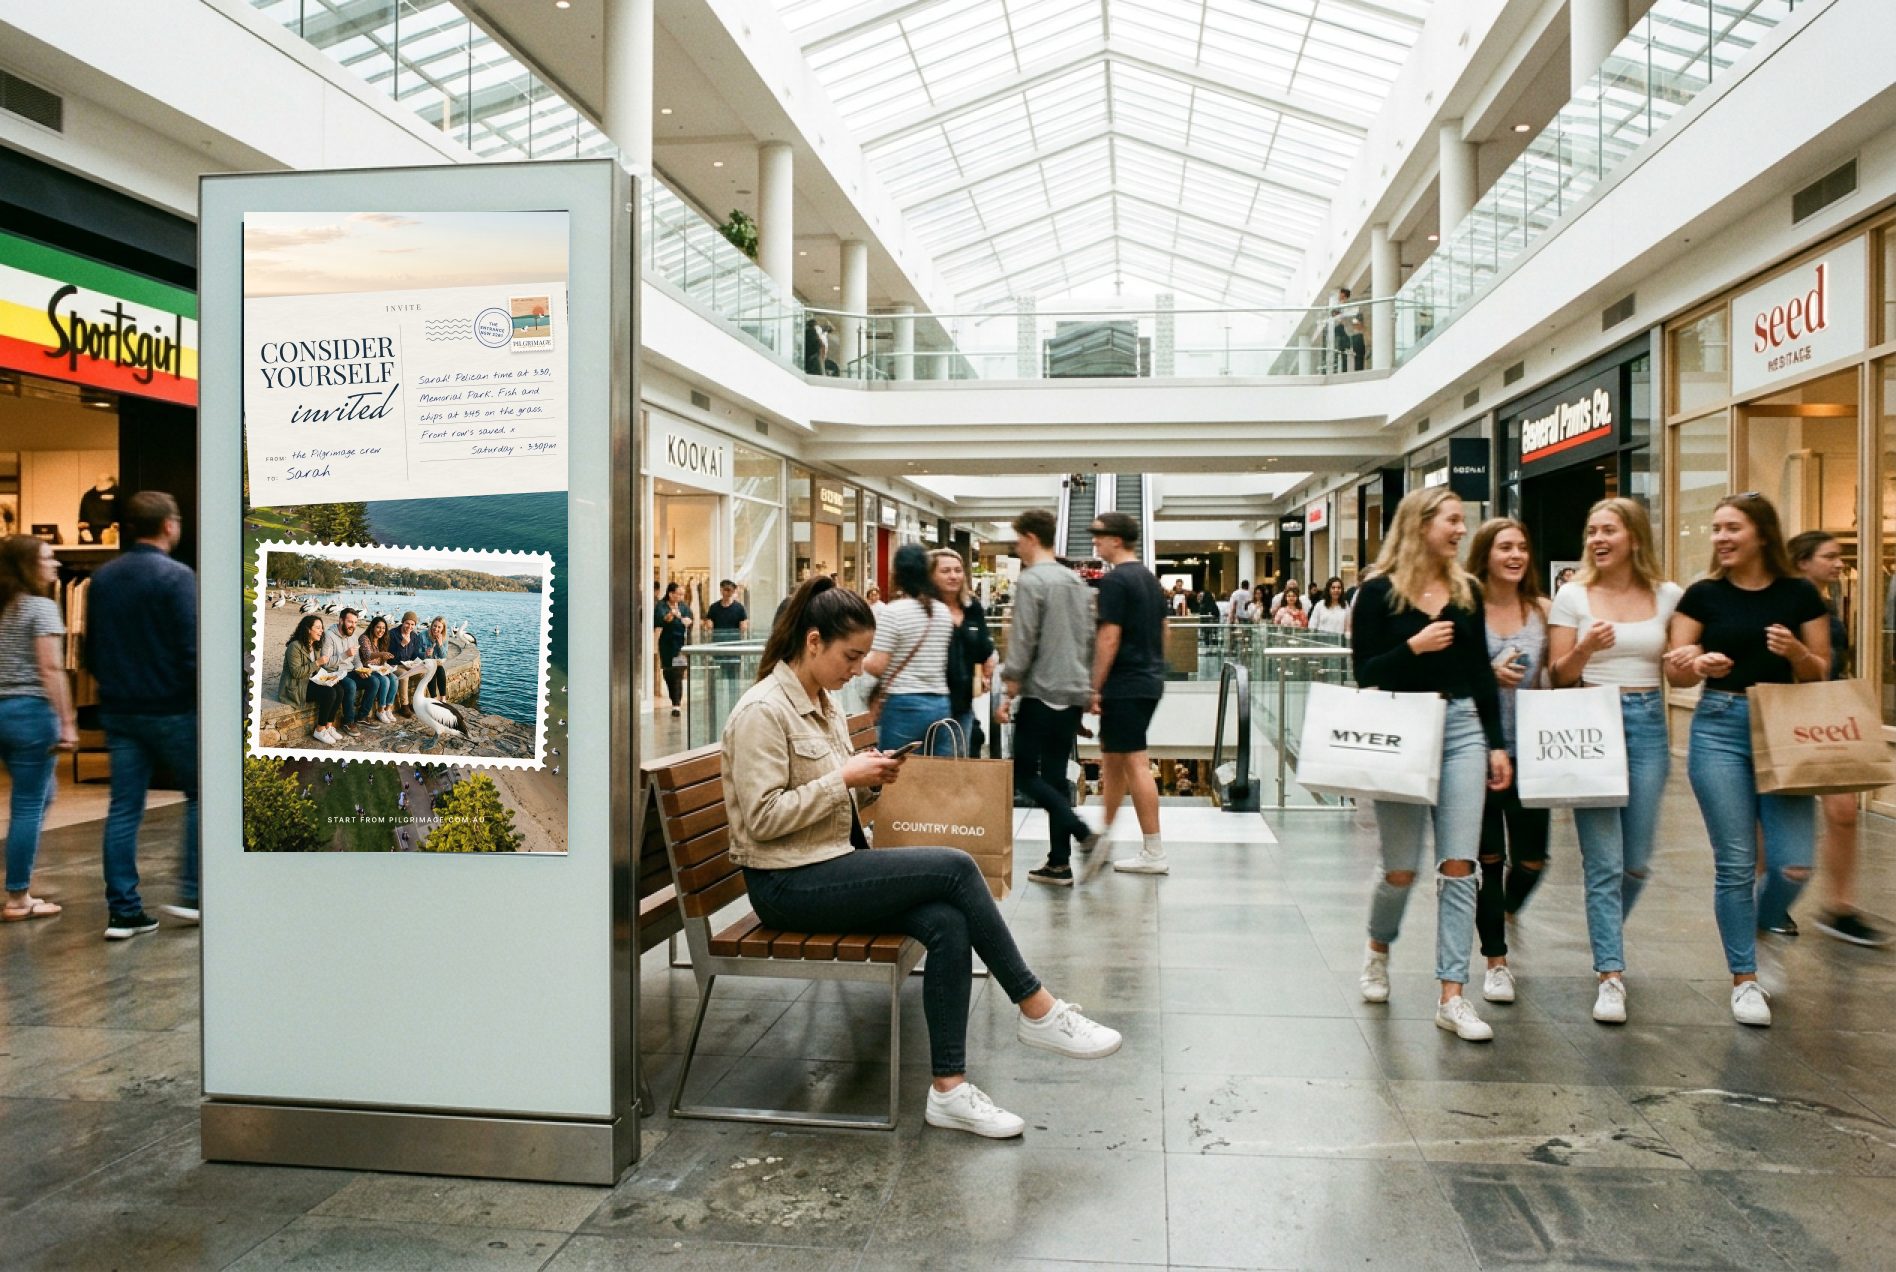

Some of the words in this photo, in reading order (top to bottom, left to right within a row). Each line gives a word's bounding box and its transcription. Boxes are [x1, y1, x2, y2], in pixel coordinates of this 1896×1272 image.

[385, 304, 422, 312] INVITE
[1755, 264, 1826, 353] seed
[44, 284, 182, 385] Sportsgirl
[480, 325, 505, 334] ENTRANCE
[261, 337, 395, 364] CONSIDER
[261, 362, 395, 389] YOURSELF
[418, 374, 450, 384] Sarah!
[455, 372, 489, 381] Pelican
[493, 371, 513, 379] time
[517, 369, 529, 378] at
[291, 383, 400, 424] invited
[420, 392, 462, 403] Memorial
[497, 387, 517, 397] Fish
[522, 387, 540, 396] and
[420, 412, 443, 424] chips
[447, 411, 459, 419] at
[500, 406, 514, 415] the
[516, 406, 543, 417] grass.
[1592, 388, 1612, 429] Co.
[420, 429, 447, 439] Front
[451, 429, 473, 437] row's
[478, 426, 506, 435] saved.
[291, 450, 307, 460] the
[310, 448, 356, 461] Pilgrimage
[360, 447, 382, 455] crew
[471, 445, 514, 456] Saturday
[286, 464, 331, 481] Sarah
[1538, 728, 1603, 745] DAVID
[1793, 716, 1863, 743] seed
[1331, 729, 1402, 748] MYER
[1536, 744, 1606, 761] JONES
[327, 816, 357, 824] START
[360, 816, 386, 824] FROM
[892, 821, 949, 835] COUNTRY
[951, 824, 986, 837] ROAD
